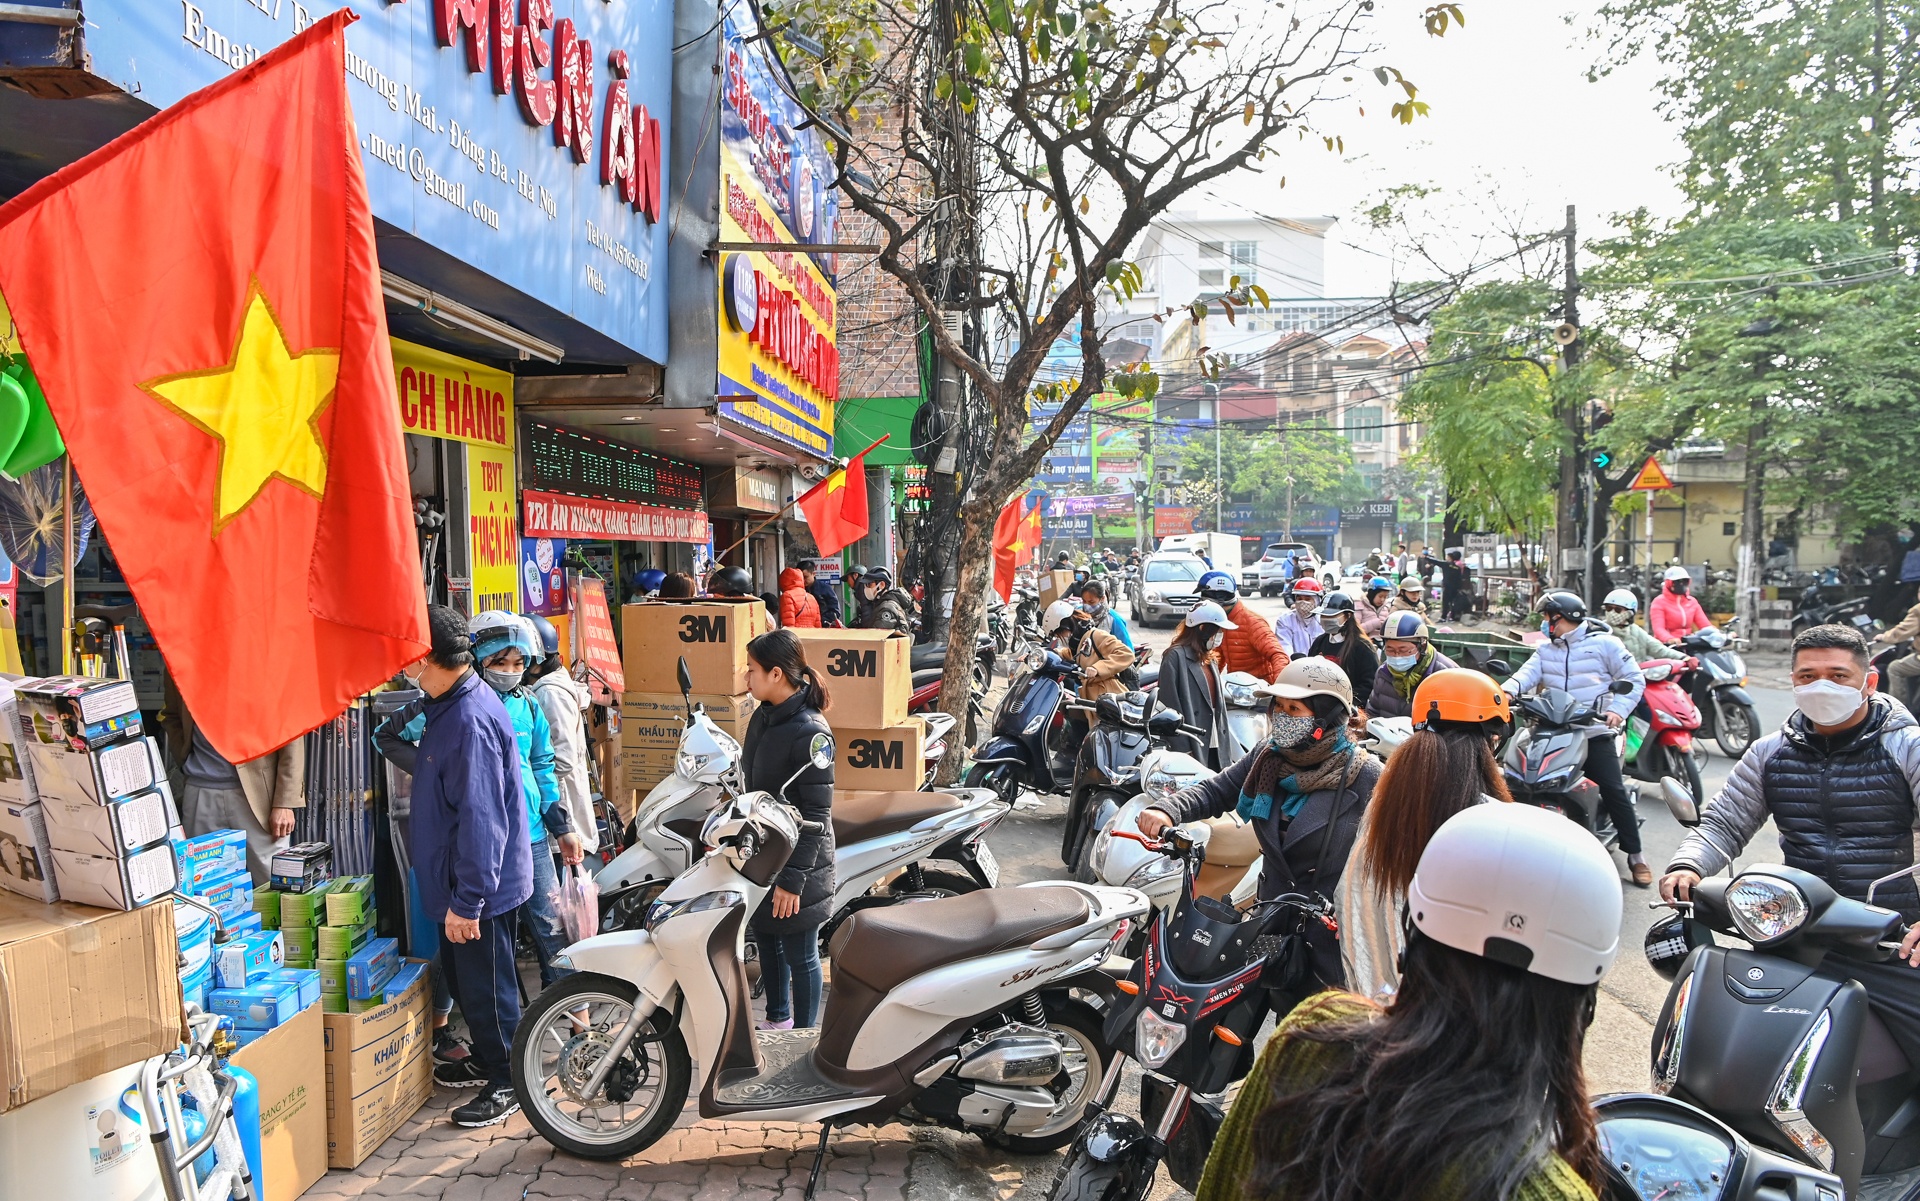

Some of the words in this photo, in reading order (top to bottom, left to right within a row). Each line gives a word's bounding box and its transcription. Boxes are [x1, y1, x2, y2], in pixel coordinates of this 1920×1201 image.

[345, 38, 400, 111] hương
[403, 84, 437, 134] Mai
[448, 119, 487, 174] Đống
[490, 148, 509, 185] Đa
[517, 170, 536, 202] Hà
[586, 219, 602, 249] Tel:
[603, 232, 613, 257] 04
[615, 241, 648, 281] 35765933
[586, 264, 607, 295] Web:
[400, 366, 437, 431] CH
[445, 371, 507, 445] HÀNG
[481, 461, 503, 493] TBYT
[1052, 465, 1066, 475] TRỢ
[1067, 464, 1090, 473] THÍNH
[528, 501, 548, 530] TRI
[571, 504, 604, 533] KHÁCH
[605, 506, 629, 534] HÀNG
[630, 505, 651, 536] GIẢM
[652, 511, 664, 537] GIÁ
[666, 511, 675, 536] CÓ
[1370, 504, 1393, 513] KEBI
[471, 500, 502, 568] THIÊN
[678, 614, 727, 643] 3M
[826, 648, 876, 678] 3M
[639, 725, 665, 737] KHẨU
[847, 738, 903, 770] 3M
[194, 851, 208, 861] NAM
[209, 848, 222, 857] ANH
[889, 834, 939, 852] VISION
[210, 896, 219, 904] AM
[220, 891, 231, 900] ANH
[1153, 889, 1176, 899] HONDA
[254, 952, 264, 965] LT
[999, 964, 1041, 988] SH
[1037, 957, 1073, 976] mode
[1210, 990, 1228, 1003] XMEN
[1228, 982, 1245, 995] PLUS
[362, 1005, 393, 1024] DANAMECO
[374, 1038, 400, 1067] KHẨU
[401, 1021, 422, 1049] TRANG
[259, 1101, 281, 1123] TRANG
[282, 1096, 288, 1107] Y
[288, 1087, 296, 1103] TẾ
[94, 1146, 120, 1161] TOILET
